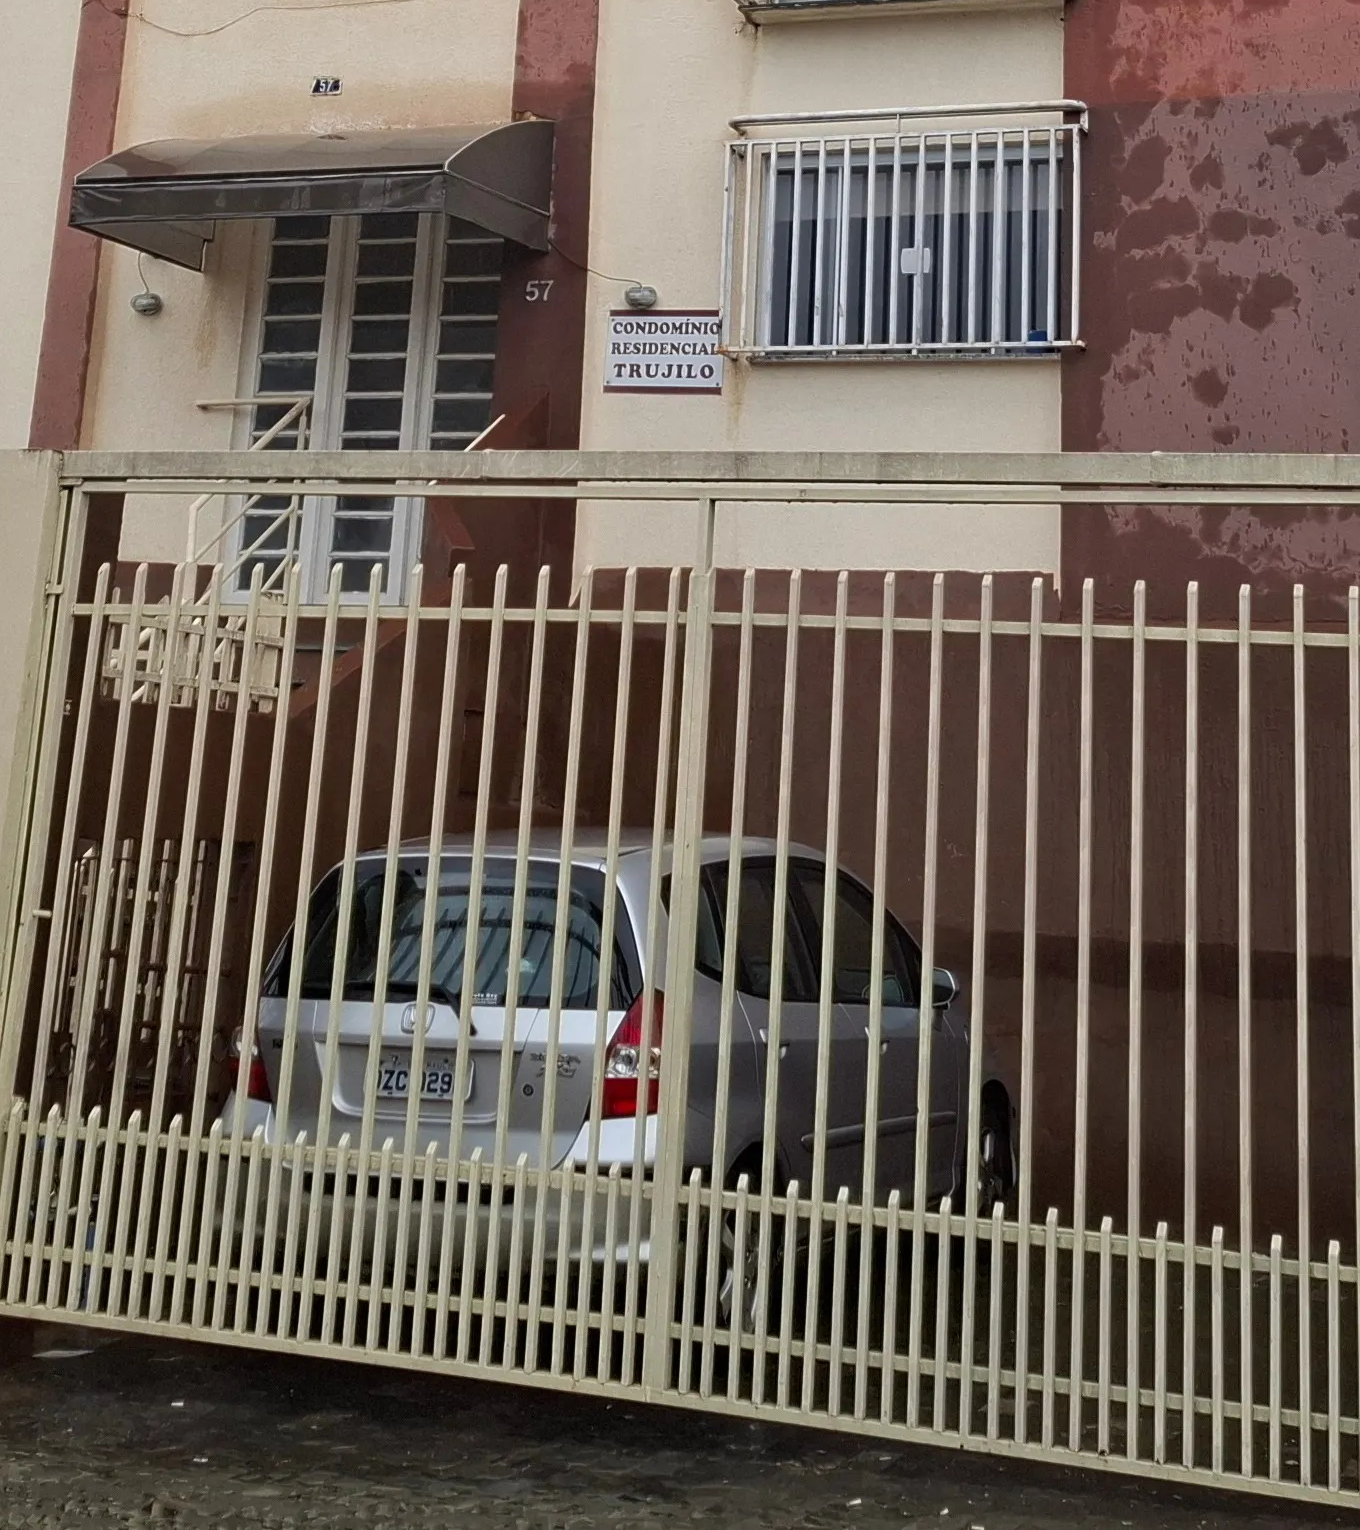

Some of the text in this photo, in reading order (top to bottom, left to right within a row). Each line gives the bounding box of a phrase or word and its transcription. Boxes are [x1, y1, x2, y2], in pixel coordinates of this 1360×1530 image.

[319, 79, 333, 92] 57
[524, 280, 554, 302] 57
[612, 318, 720, 335] CONDOMÍNIO
[611, 342, 718, 356] RESIDENCIAL
[613, 363, 715, 379] TRUJILO
